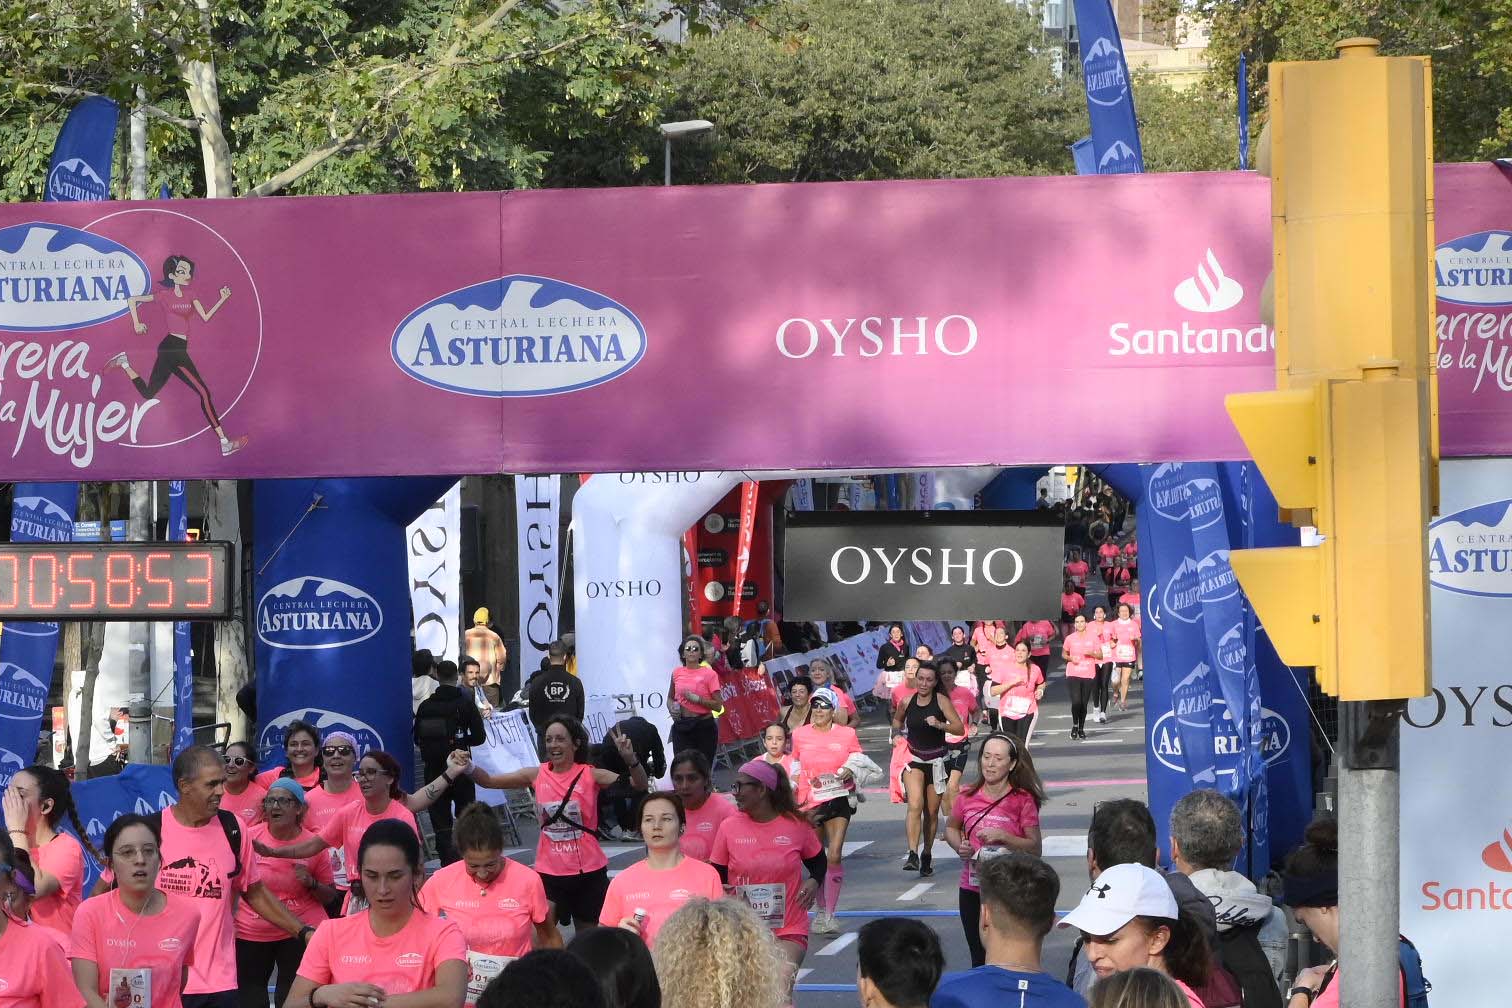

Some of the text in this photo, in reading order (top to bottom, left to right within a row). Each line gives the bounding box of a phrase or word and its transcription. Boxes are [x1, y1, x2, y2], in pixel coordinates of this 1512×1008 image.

[54, 258, 126, 270] LECHERA
[450, 316, 618, 330] CENTRAL LECHERA
[775, 313, 978, 359] OYSHO
[411, 322, 626, 367] ASTURIANA
[1109, 322, 1275, 355] Santand
[11, 375, 160, 468] Mujer
[11, 518, 72, 542] STURIANA
[830, 546, 1024, 587] OYSHO
[586, 580, 661, 599] OYSHO
[261, 605, 373, 633] ASTURIANA
[551, 687, 564, 696] BP
